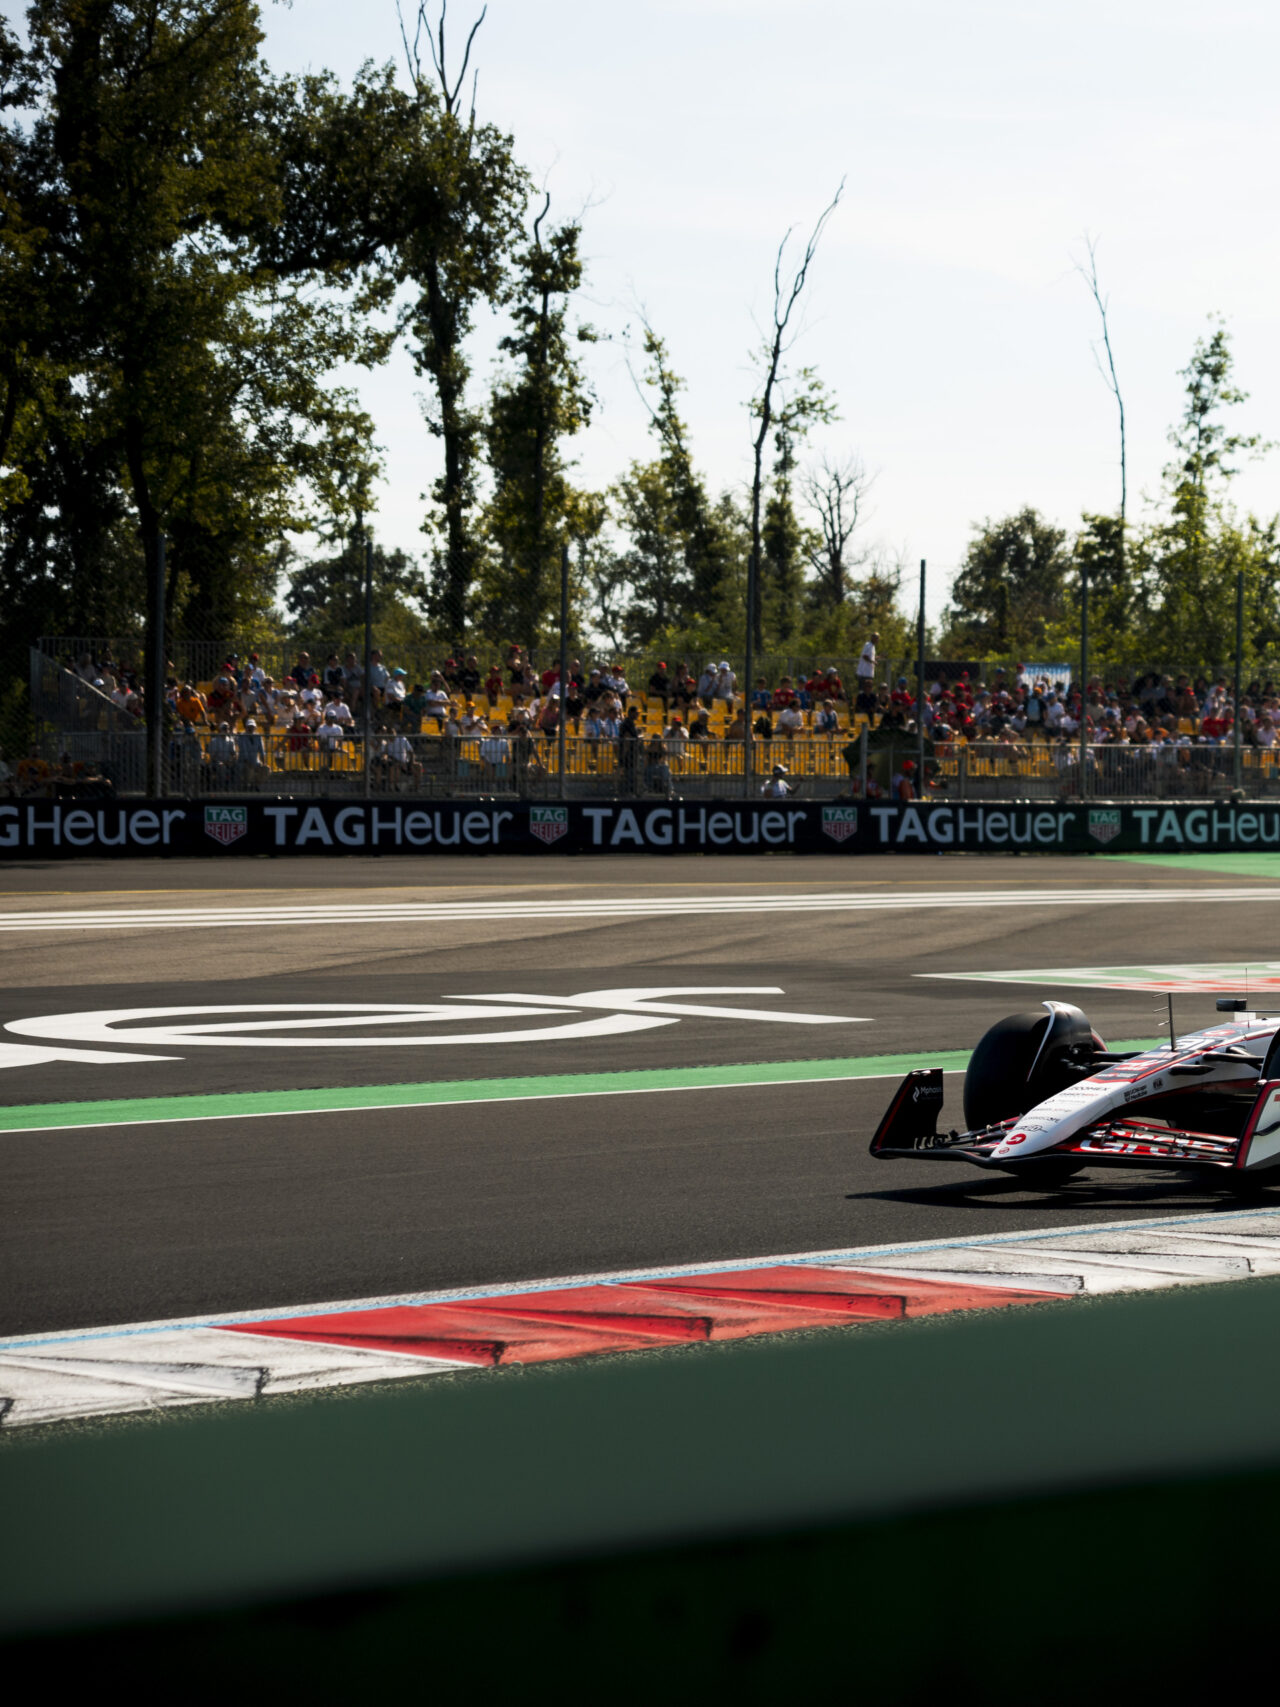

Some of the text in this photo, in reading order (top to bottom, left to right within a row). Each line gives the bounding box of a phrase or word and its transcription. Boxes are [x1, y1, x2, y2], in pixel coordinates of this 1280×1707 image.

[208, 809, 244, 822] TAG
[533, 809, 565, 822] TAG
[825, 809, 855, 821] TAG
[1092, 812, 1118, 823] TAG
[207, 823, 244, 842] HEUER
